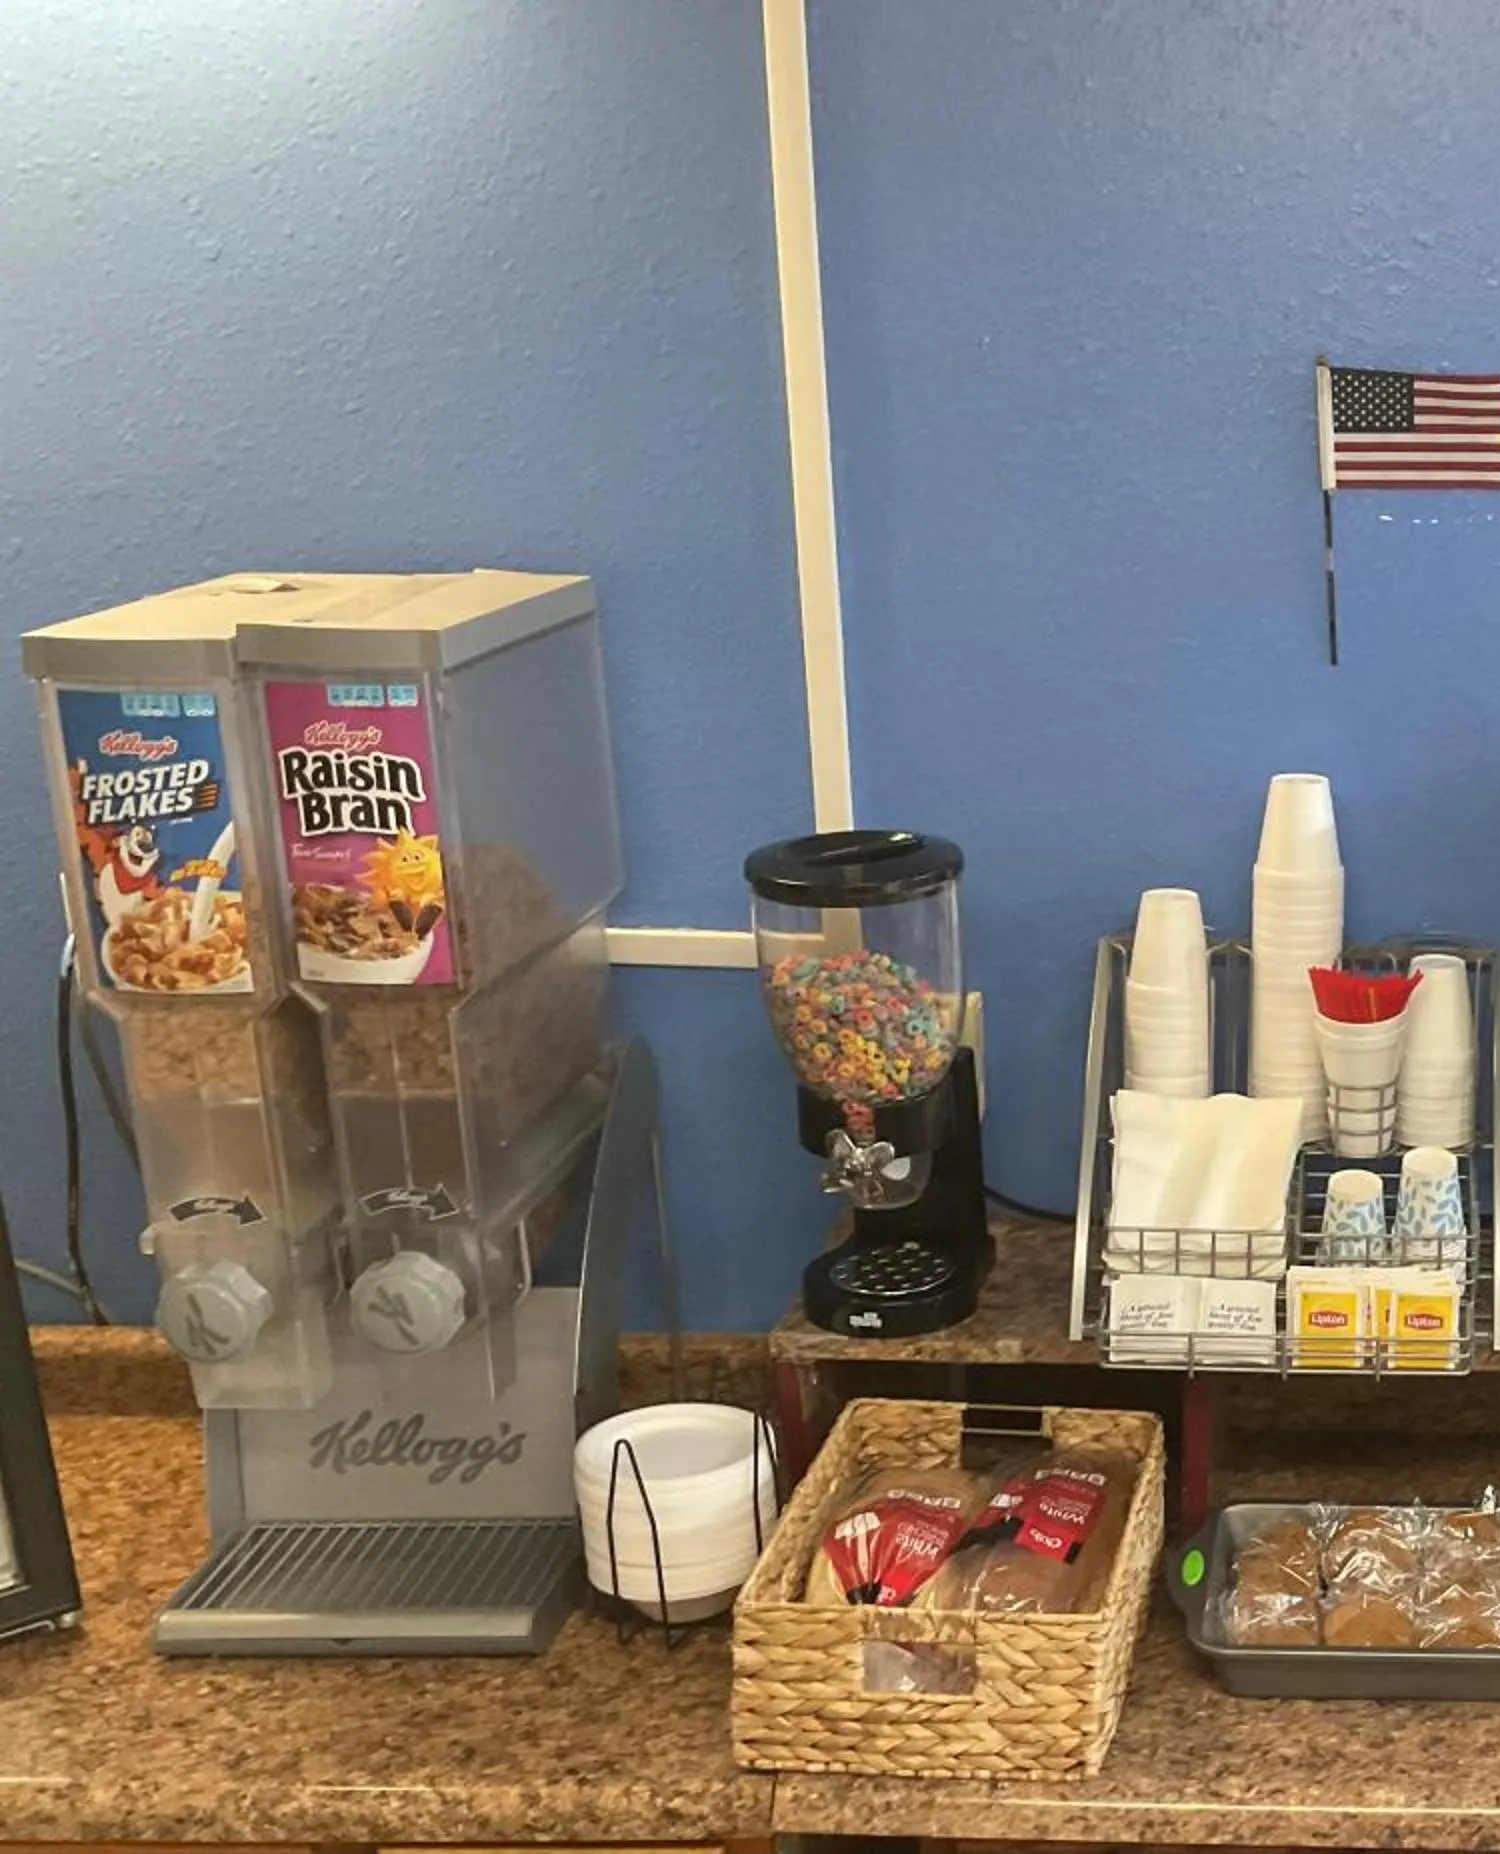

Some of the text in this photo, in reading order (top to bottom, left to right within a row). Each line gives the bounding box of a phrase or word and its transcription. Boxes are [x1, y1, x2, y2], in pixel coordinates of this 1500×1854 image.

[99, 729, 179, 761] Kellogg's
[303, 719, 383, 752] Kellogg's
[82, 759, 209, 800] FROSTED
[280, 748, 424, 802] Raisin
[87, 786, 194, 825] FLAKES
[300, 788, 413, 835] Bran
[1311, 1313, 1346, 1326] Lipton
[1406, 1315, 1442, 1329] Lipton
[309, 1408, 528, 1486] Kellogg's
